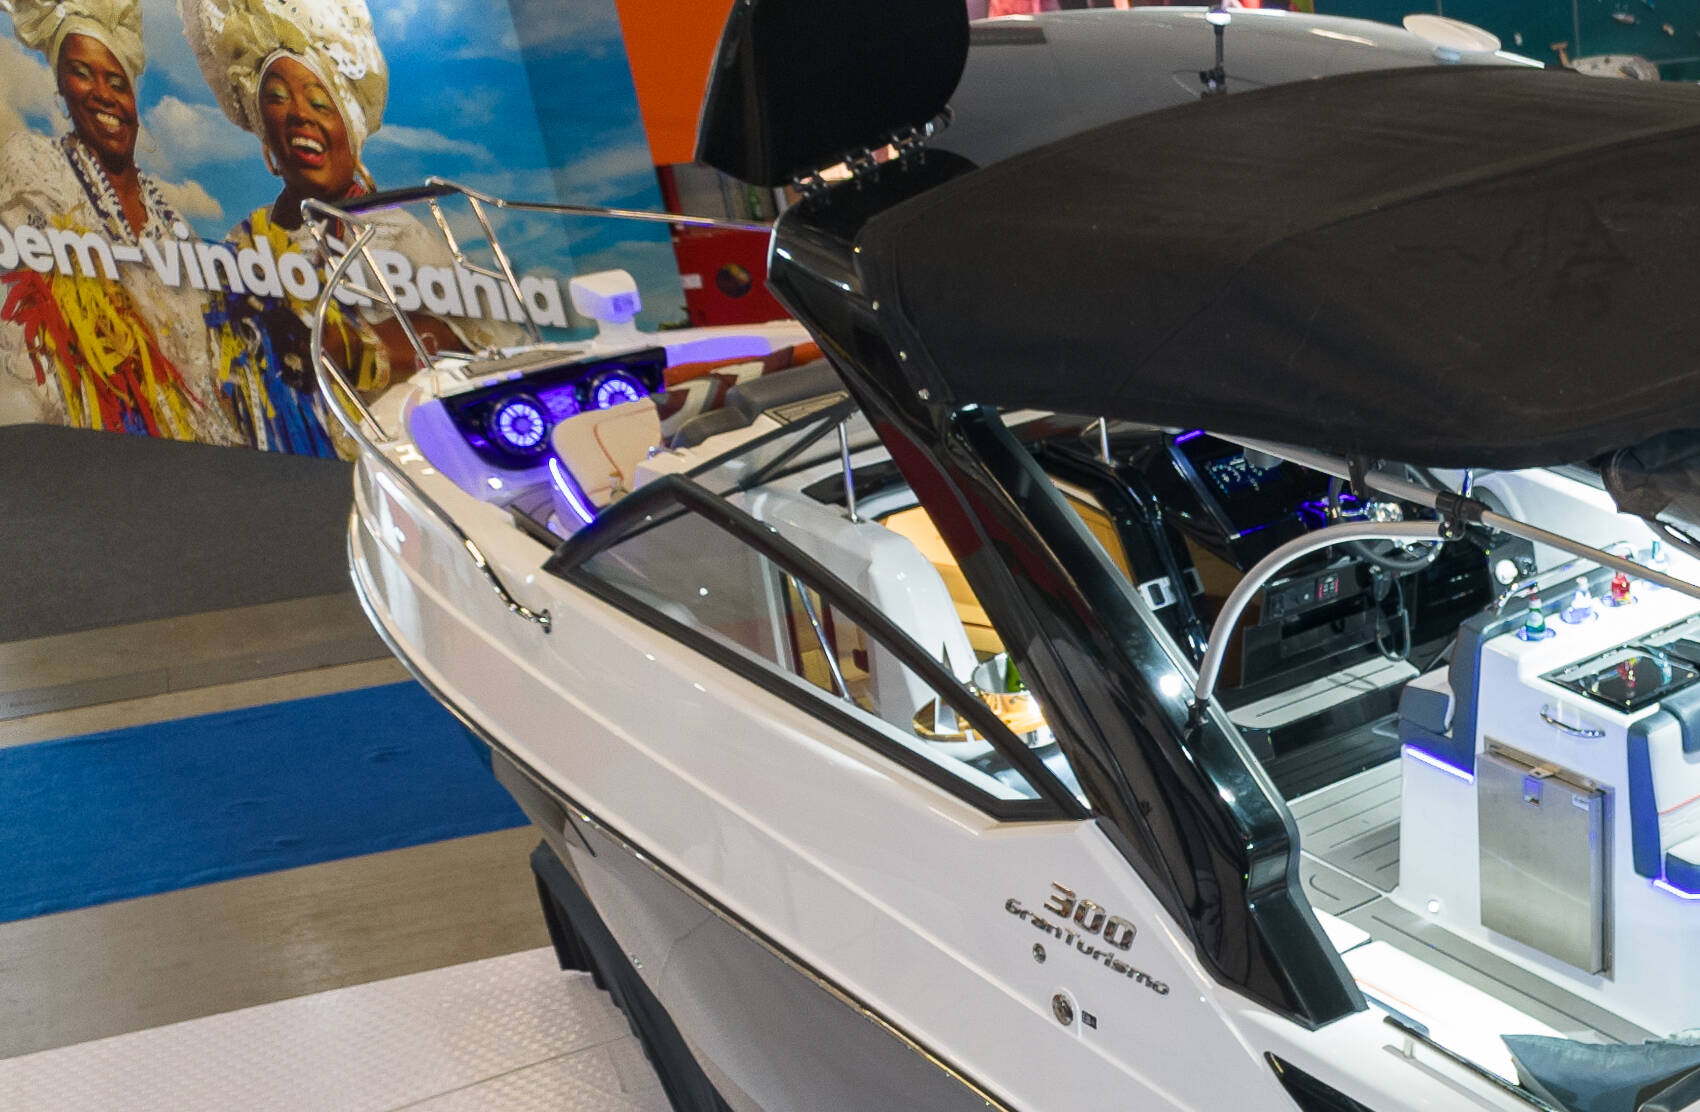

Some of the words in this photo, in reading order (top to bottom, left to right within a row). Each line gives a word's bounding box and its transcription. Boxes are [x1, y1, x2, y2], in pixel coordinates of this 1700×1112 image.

[367, 250, 567, 328] Bahia
[1005, 898, 1169, 995] GranTurismo
[1043, 881, 1138, 951] 300
